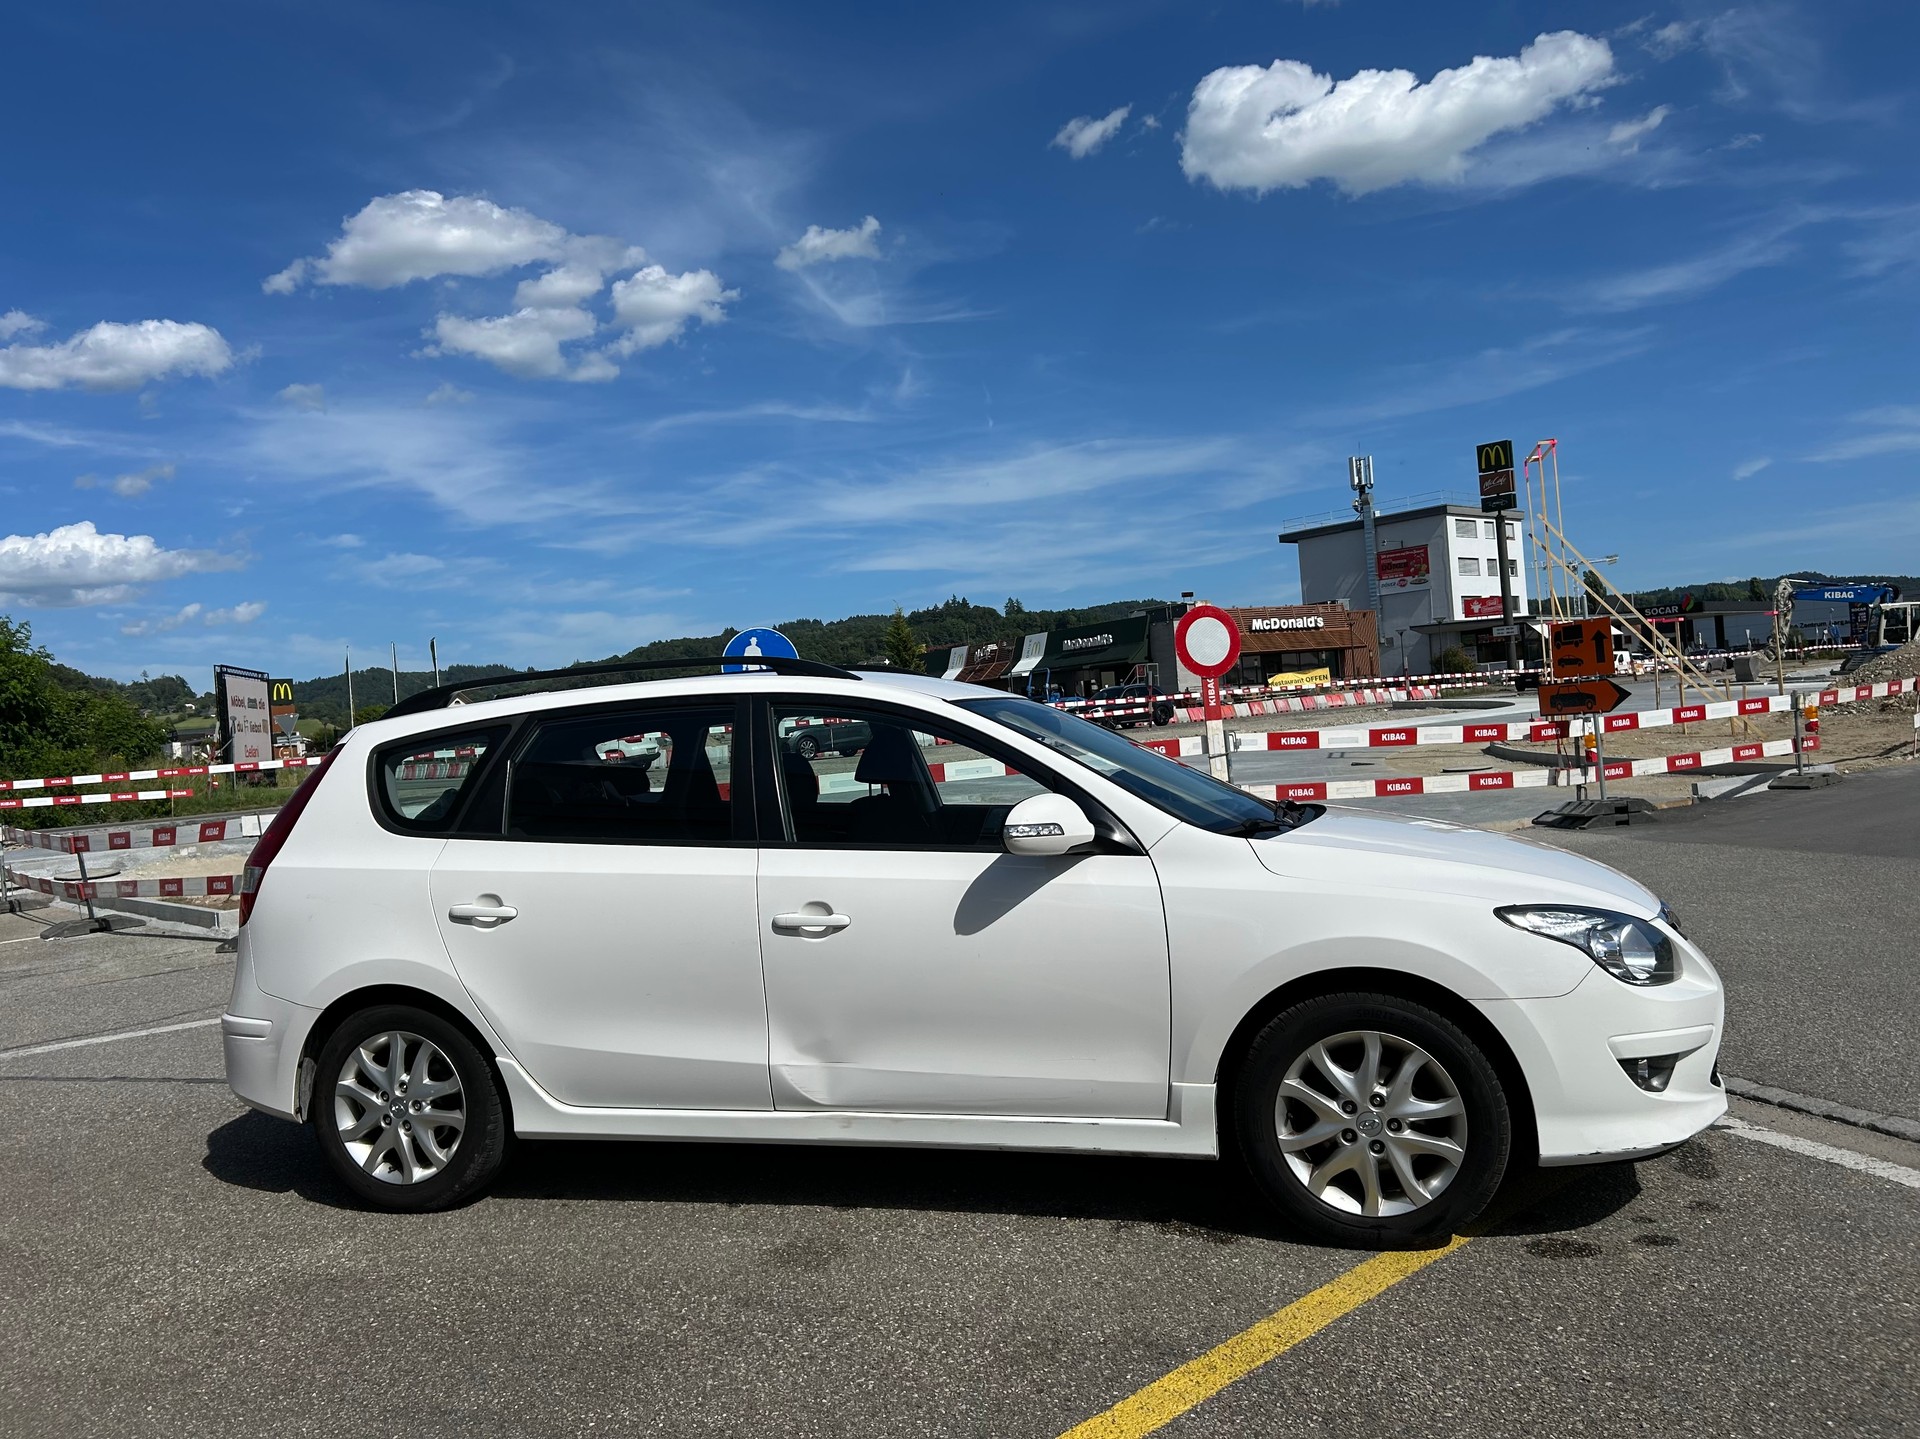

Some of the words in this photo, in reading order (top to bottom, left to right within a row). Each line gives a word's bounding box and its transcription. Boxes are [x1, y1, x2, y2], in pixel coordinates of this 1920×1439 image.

[1824, 591, 1854, 599] KIBAG
[1644, 605, 1679, 616] SOCAR
[1251, 616, 1325, 631] McDonald's
[1271, 677, 1304, 687] Restaurant
[1305, 674, 1328, 683] OFFEN
[231, 695, 246, 709] Möbel,
[1823, 694, 1834, 702] KIBAG
[1745, 702, 1762, 710] KIBAG
[1680, 710, 1698, 719] KIBAG
[237, 722, 243, 733] du
[250, 721, 262, 733] liebst
[1612, 718, 1630, 727] KIBAG
[1475, 728, 1498, 737] KIBAG
[1541, 727, 1561, 736] KIBAG
[1281, 736, 1307, 745] KIBAG
[1381, 733, 1406, 741] KIBAG
[1740, 748, 1756, 757] KIBAG
[1675, 757, 1693, 766] KIBAG
[1604, 767, 1624, 776] KIBAG
[1480, 777, 1503, 786] KIBAG
[1387, 783, 1411, 791] KIBAG
[1288, 788, 1314, 797] KIBAG
[205, 827, 219, 836] KIBAG
[113, 837, 126, 845] KIBAG
[158, 833, 171, 841] KIBAG
[165, 883, 177, 891] KIBAG
[213, 881, 226, 890] KIBAG
